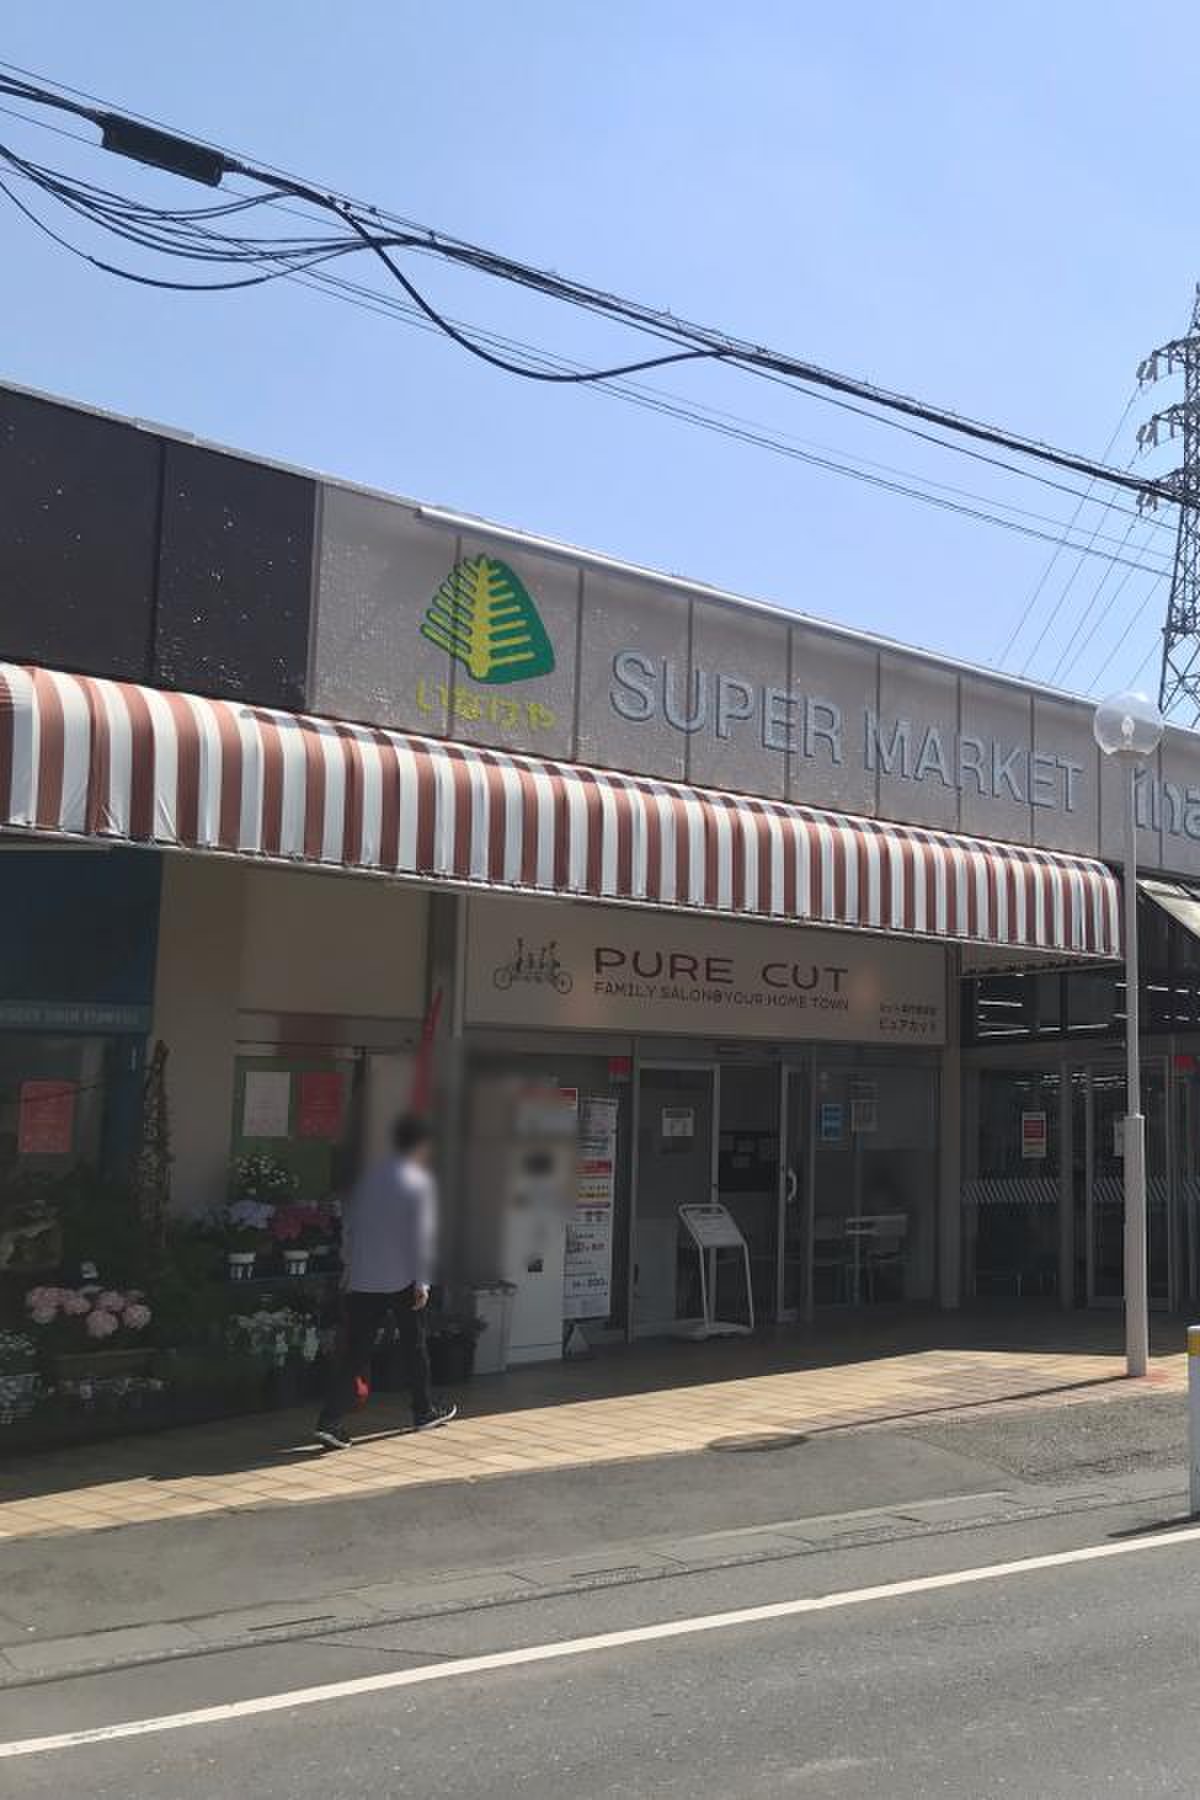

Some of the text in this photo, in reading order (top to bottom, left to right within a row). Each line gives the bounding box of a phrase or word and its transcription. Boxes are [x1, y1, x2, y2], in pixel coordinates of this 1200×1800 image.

[609, 648, 1083, 812] SUPER MARKET
[594, 947, 849, 992] PURE CUT
[593, 981, 656, 998] FAMILY
[767, 994, 808, 1009] HOME
[812, 997, 849, 1011] TOWN
